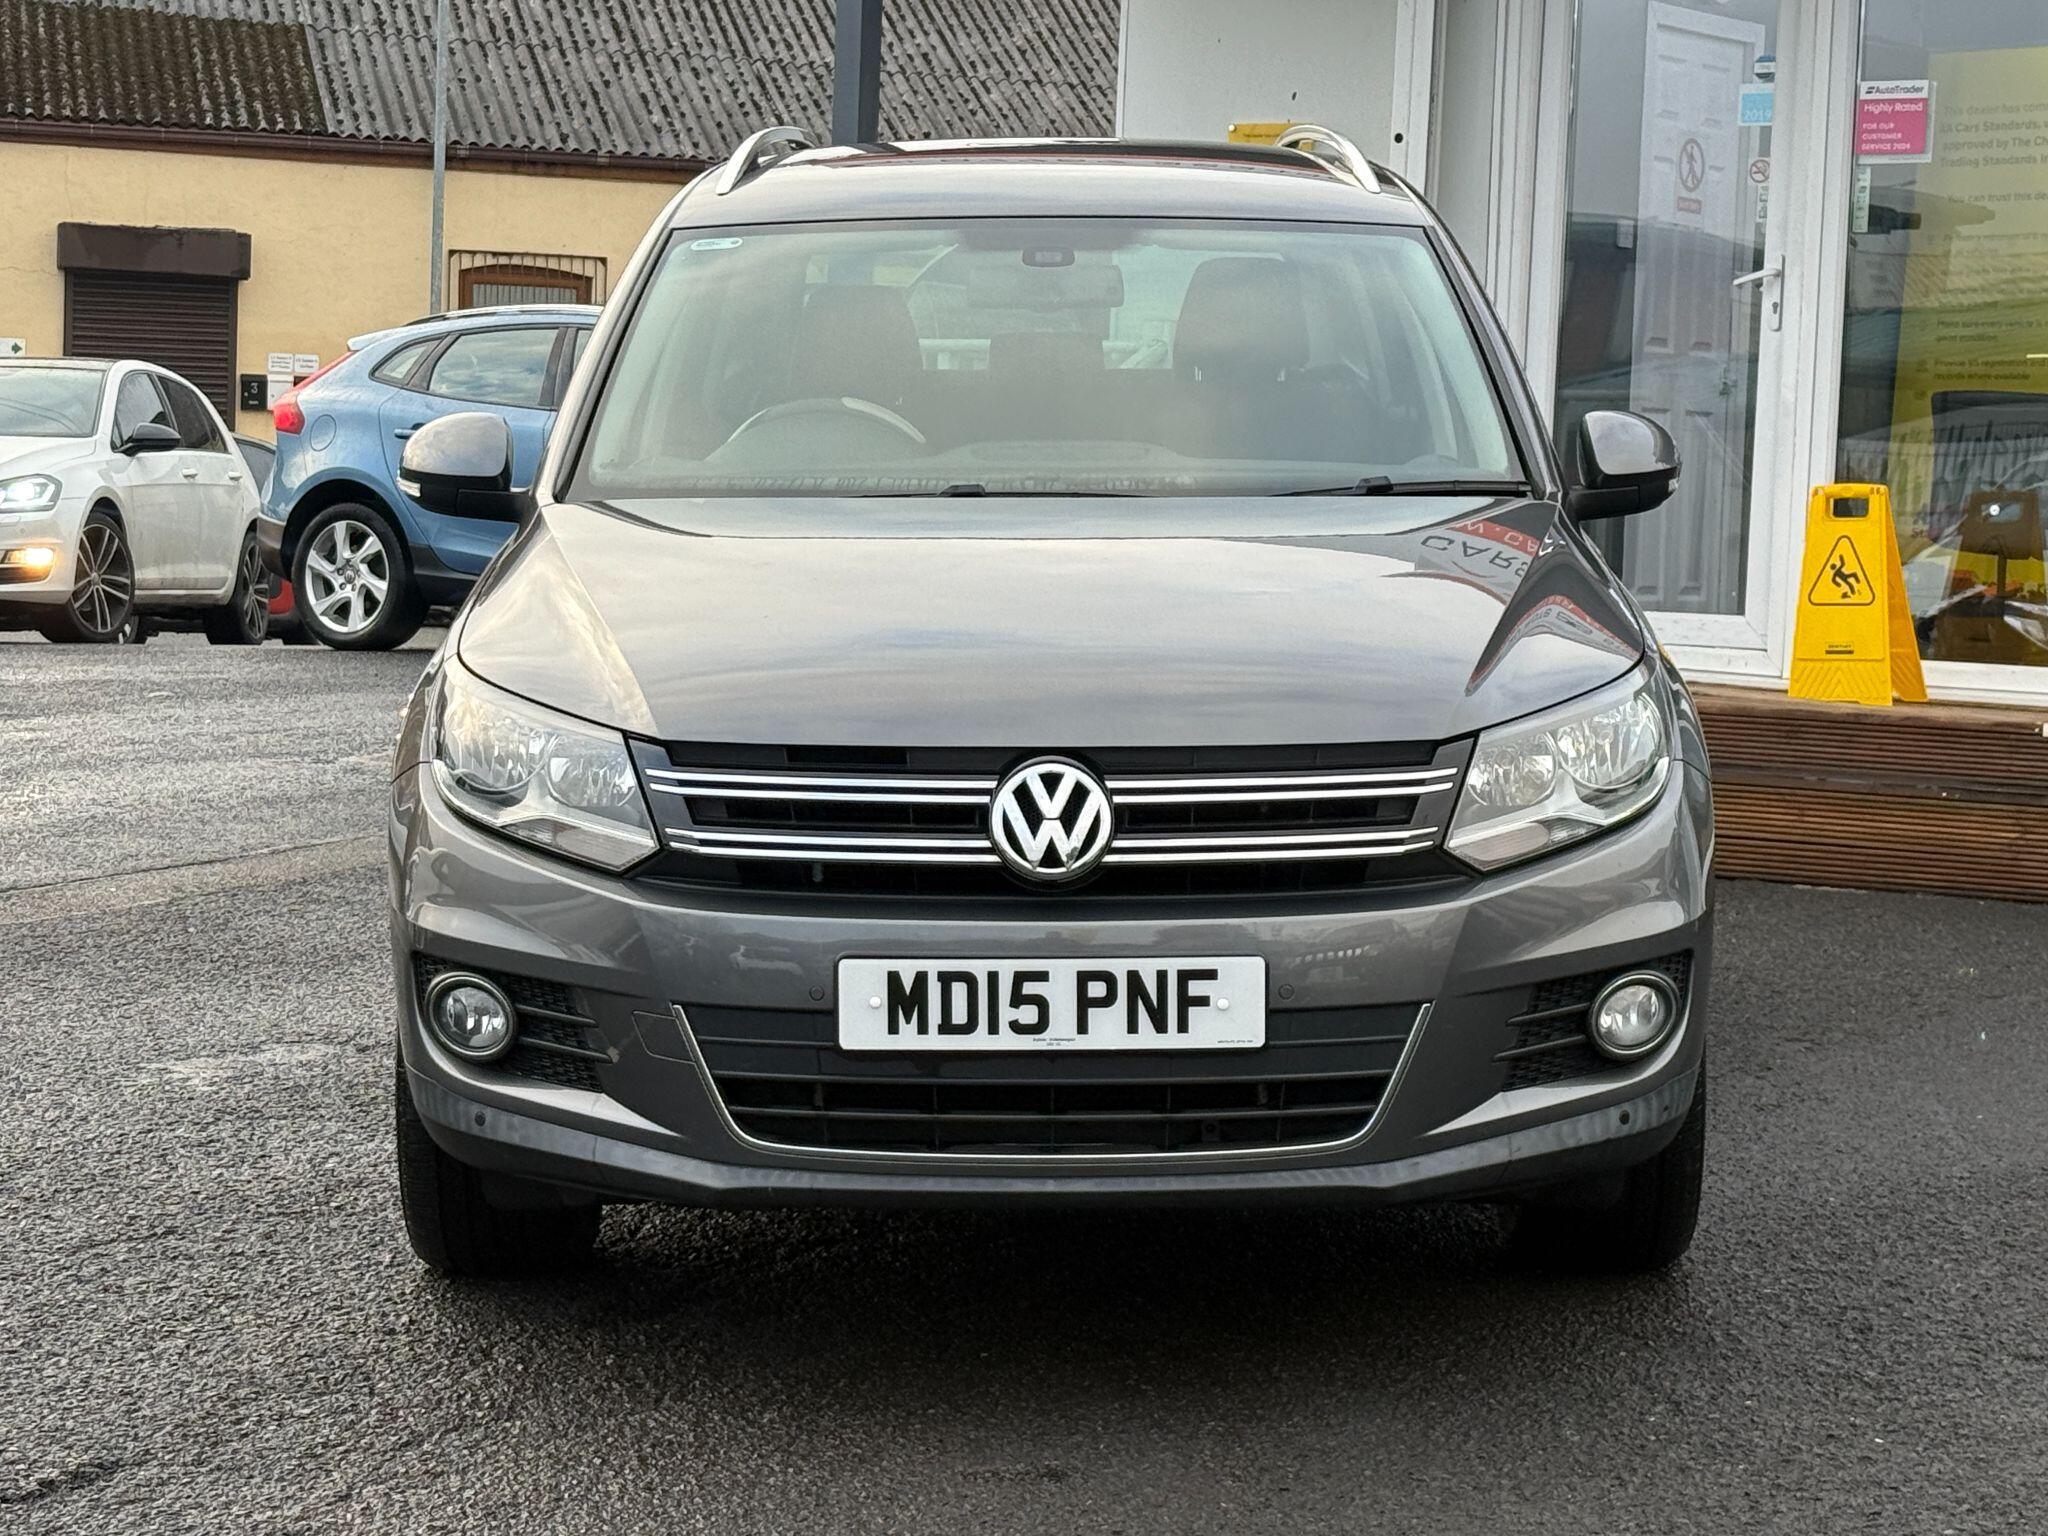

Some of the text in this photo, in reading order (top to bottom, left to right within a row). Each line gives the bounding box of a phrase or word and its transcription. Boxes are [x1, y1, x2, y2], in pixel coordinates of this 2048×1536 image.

[1874, 84, 1925, 95] AutoTrader
[1864, 101, 1923, 114] Highly Rated
[1879, 122, 1895, 130] OUR
[1862, 132, 1902, 140] CUSTOMER
[1861, 143, 1891, 151] SERVICE
[1943, 139, 1995, 152] approved
[1996, 138, 2009, 150] by
[2010, 137, 2032, 147] The
[1982, 155, 2037, 167] Standards
[250, 382, 259, 394] 3
[886, 968, 1219, 1036] MD15 PNF
